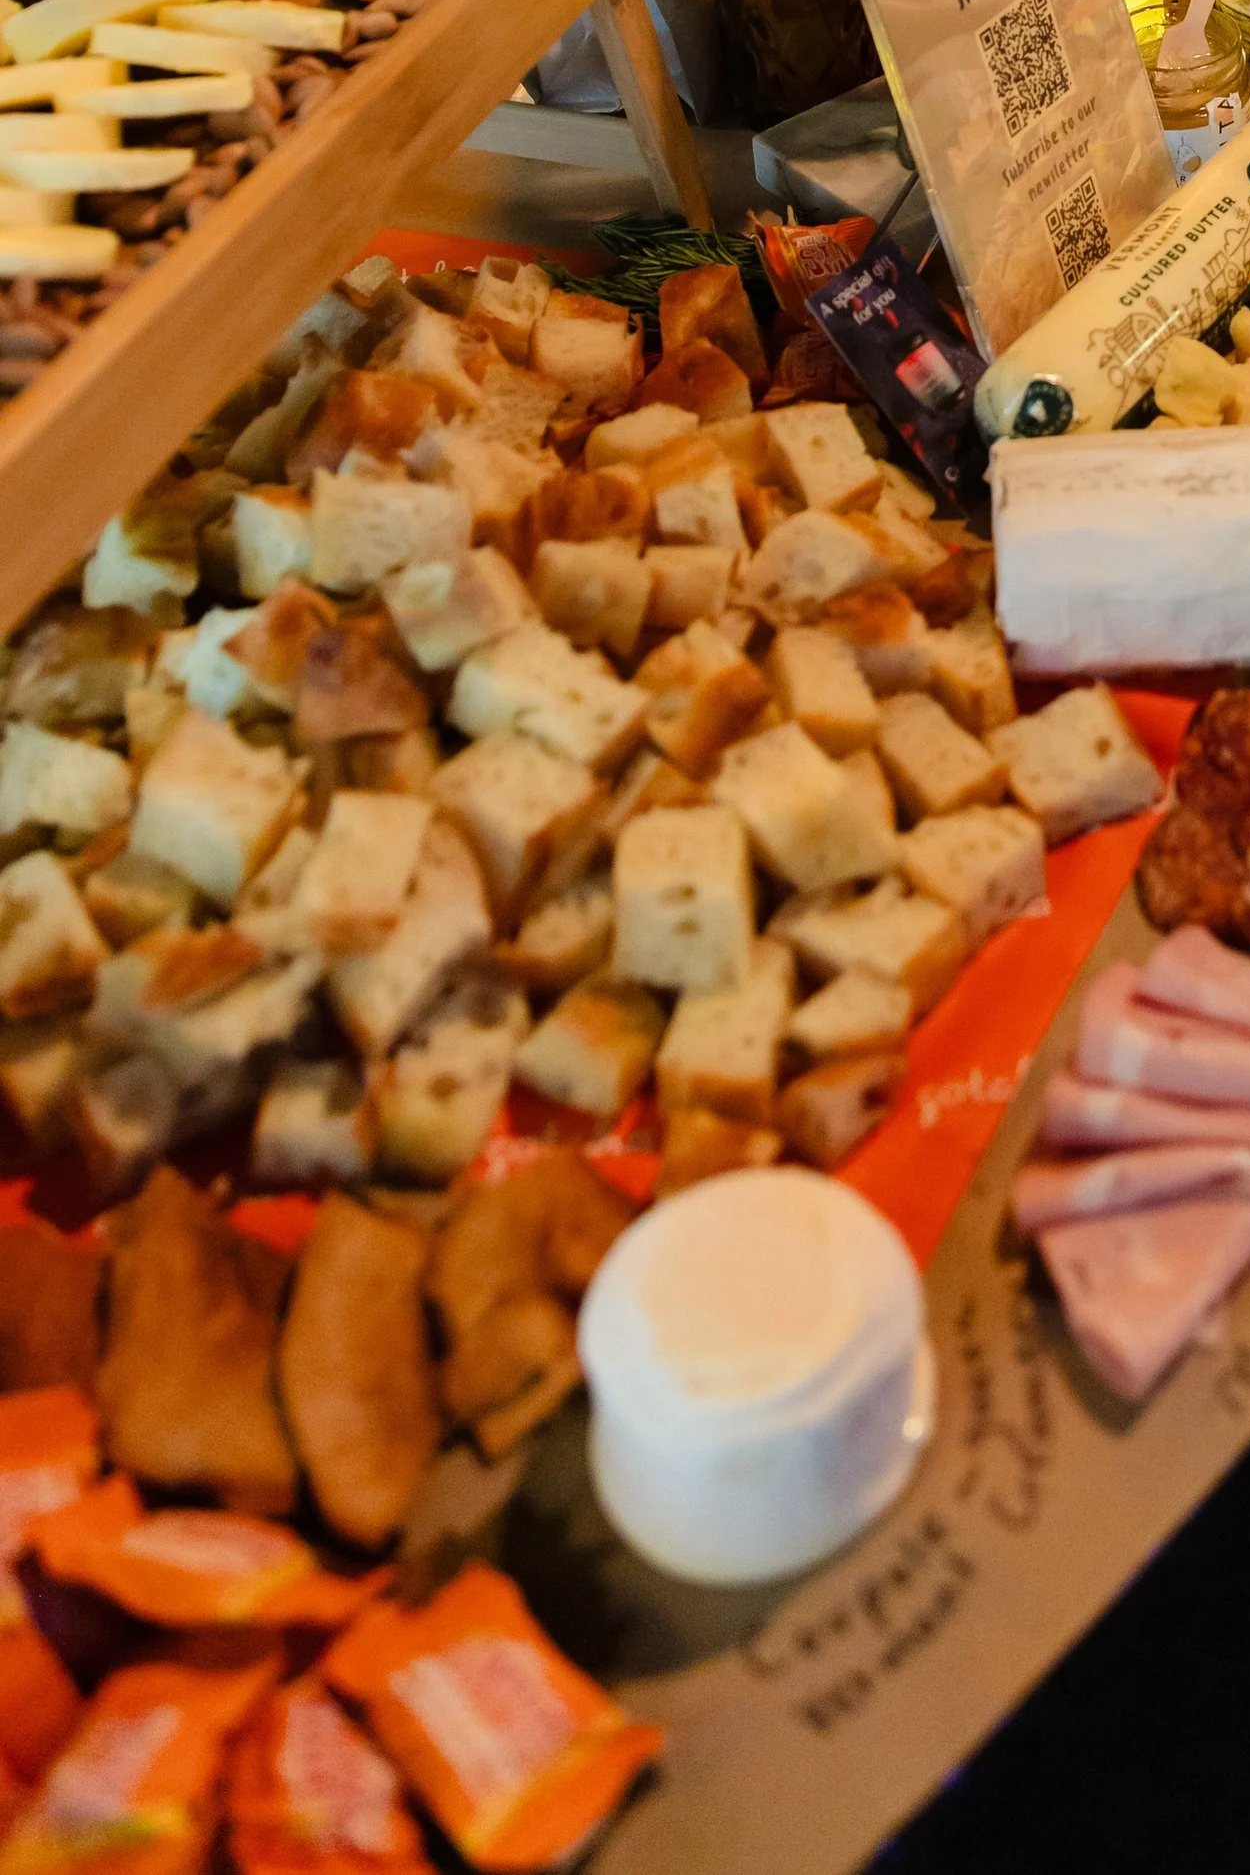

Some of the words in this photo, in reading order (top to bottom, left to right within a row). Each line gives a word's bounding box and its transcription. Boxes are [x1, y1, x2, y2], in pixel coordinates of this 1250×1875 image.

[1002, 127, 1060, 188] Subscribe
[1060, 113, 1075, 135] to
[1076, 94, 1097, 126] our
[1027, 137, 1092, 203] newsletter
[1100, 206, 1183, 274] VERMONT
[1119, 242, 1187, 308] CULTURED
[1185, 195, 1236, 243] BUTTER
[819, 302, 835, 319] A
[831, 270, 873, 310] special
[872, 287, 897, 316] you
